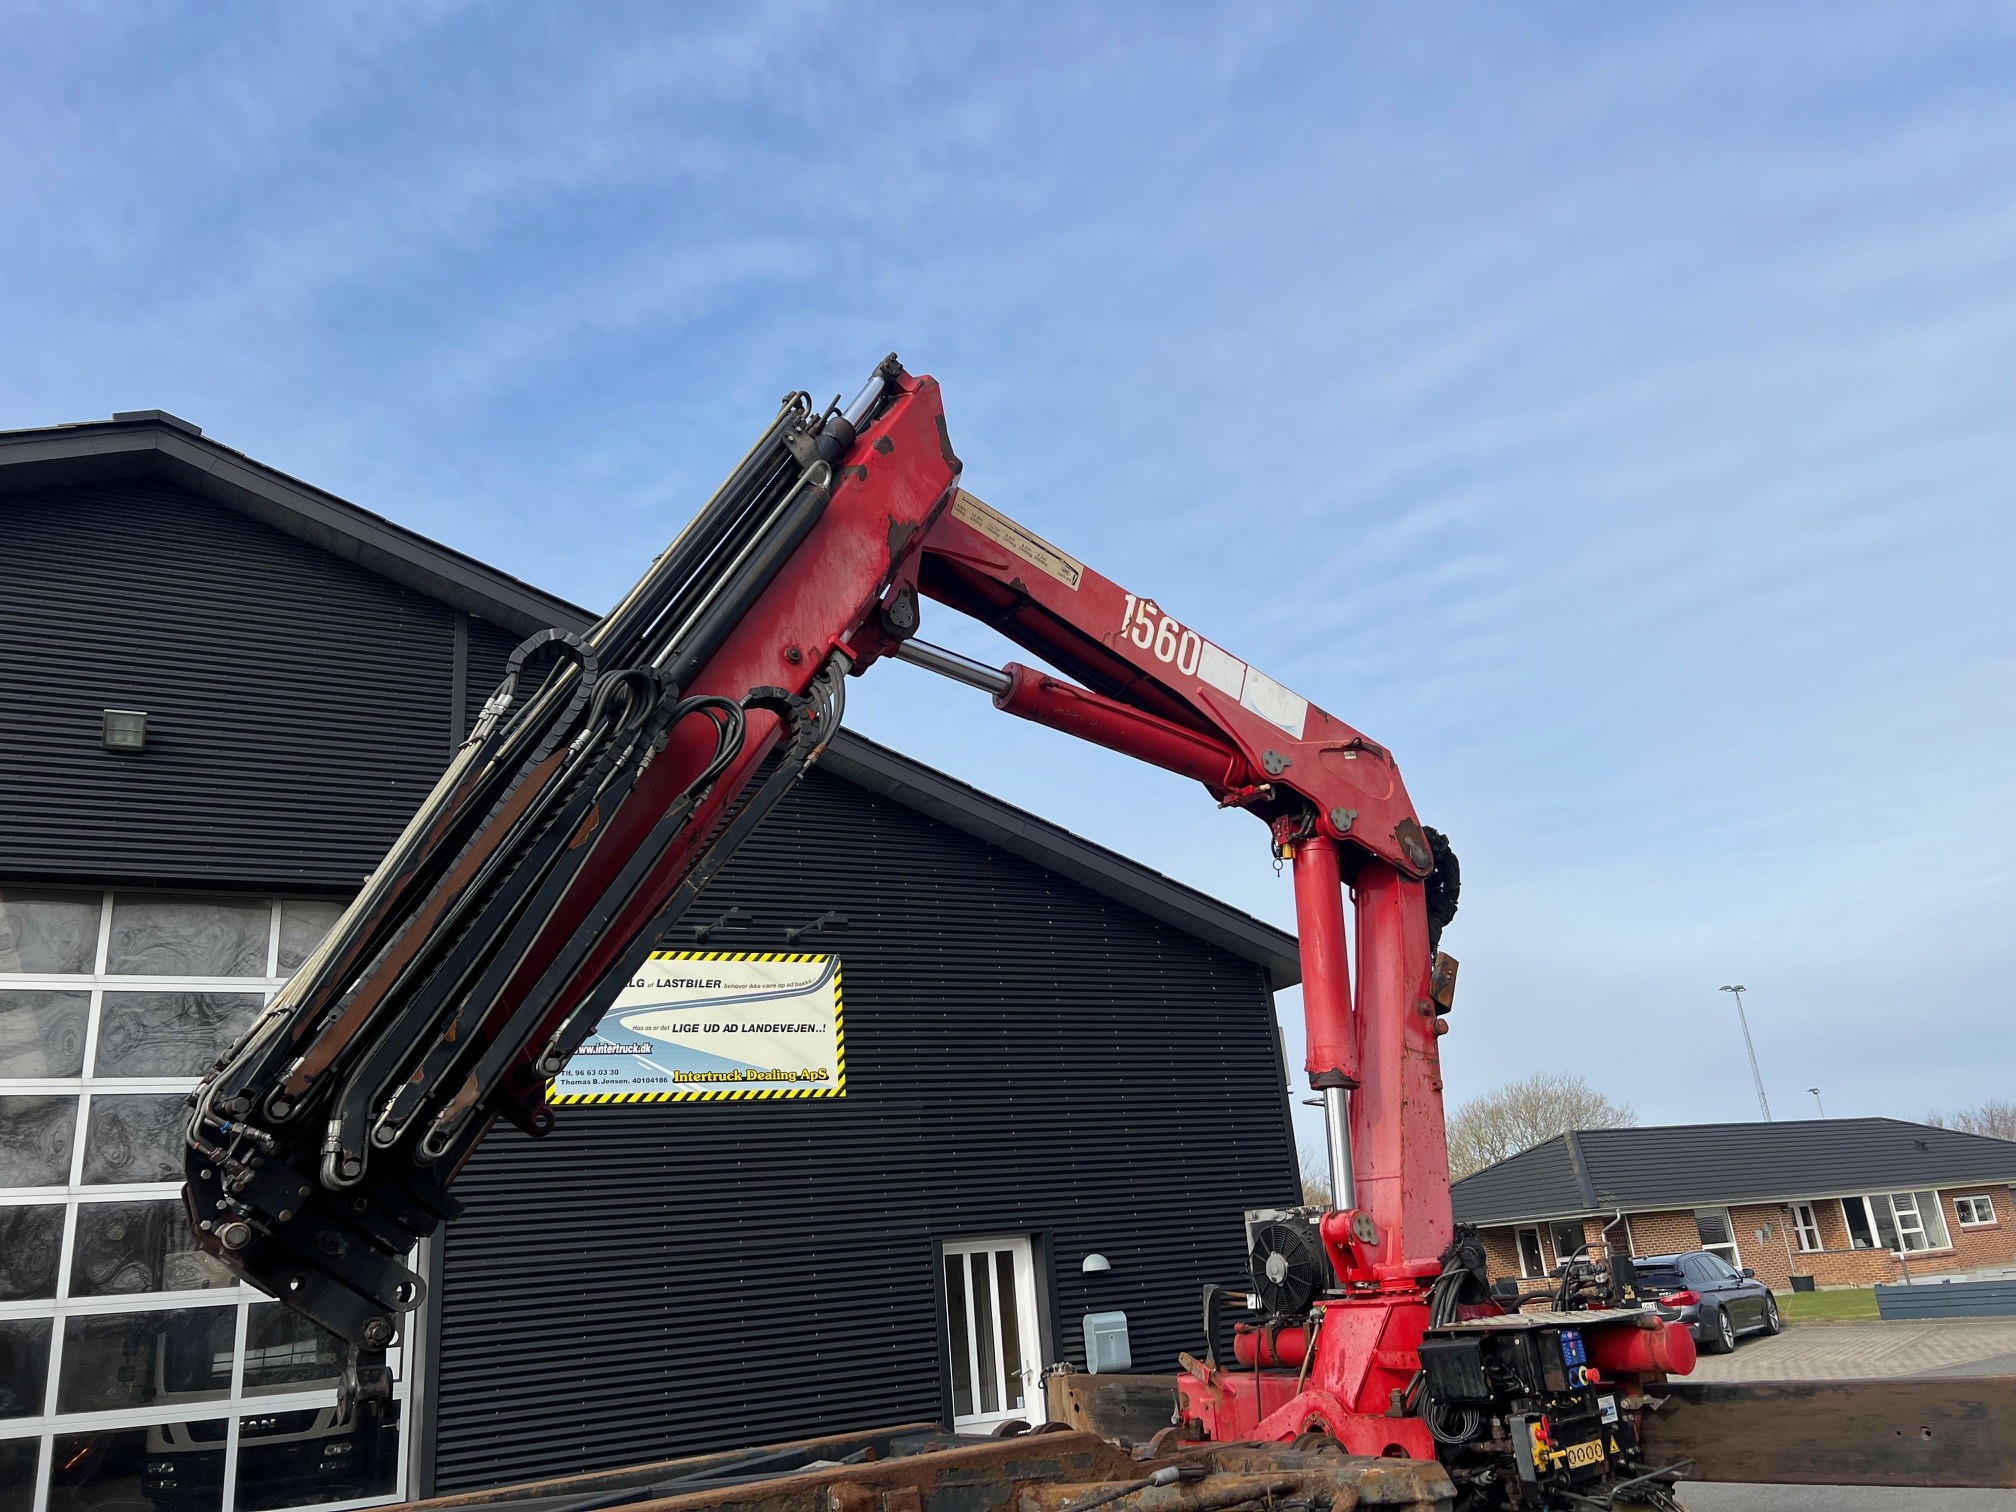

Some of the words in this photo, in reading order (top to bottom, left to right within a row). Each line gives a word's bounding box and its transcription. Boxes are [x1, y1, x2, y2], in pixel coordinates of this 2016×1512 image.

[1121, 594, 1202, 676] 1560
[656, 978, 722, 988] LASTBILER
[672, 1023, 700, 1033] LIGE
[703, 1023, 720, 1033] UD
[722, 1023, 739, 1033] AD
[741, 1023, 827, 1033] LANDEVEJEN..!
[574, 1042, 653, 1054] ww.intertruck.dk
[673, 1069, 743, 1083] Intertruck
[746, 1069, 797, 1083] Dealing
[800, 1068, 829, 1082] ApS
